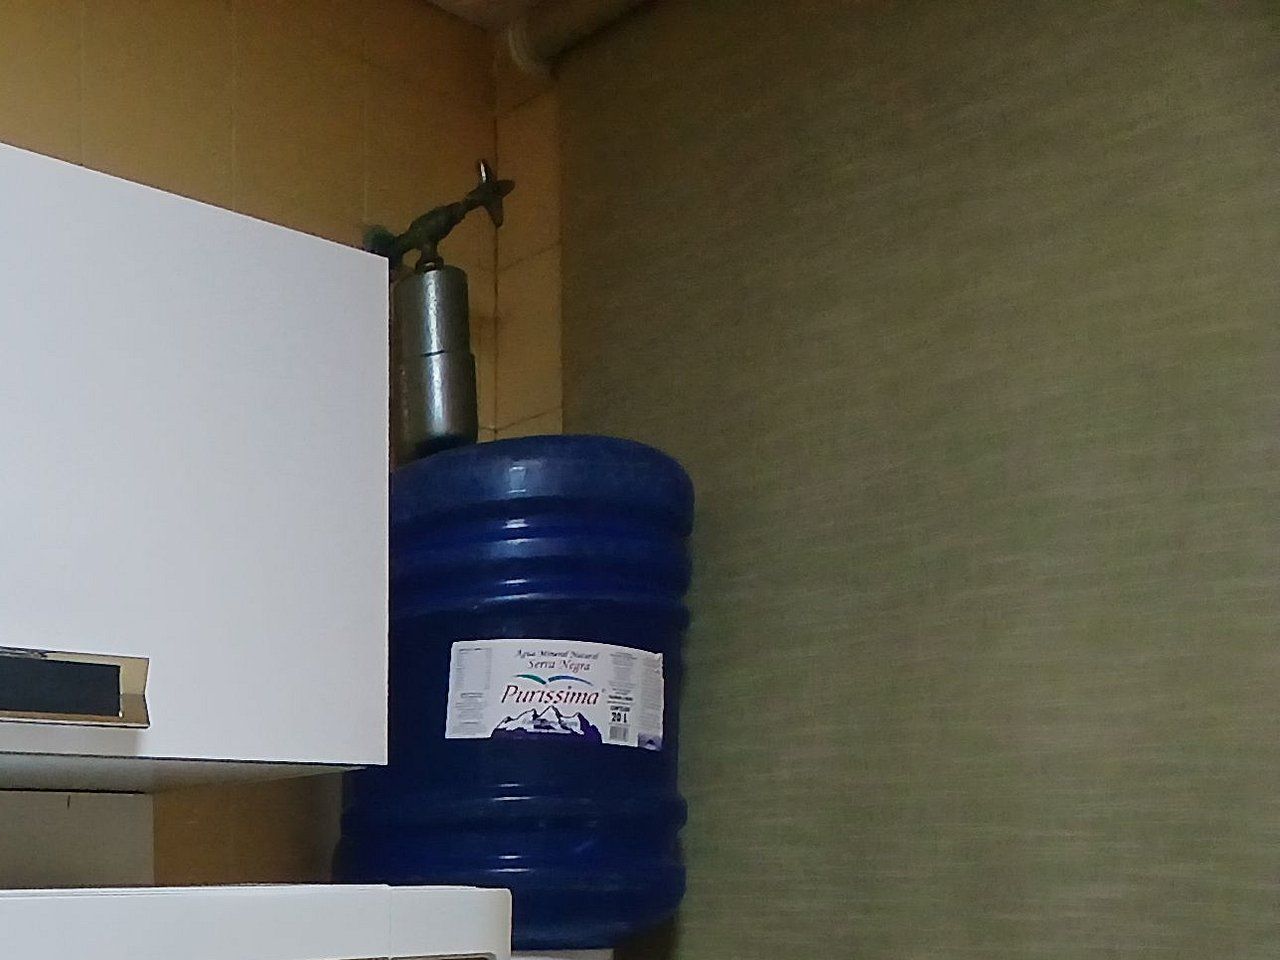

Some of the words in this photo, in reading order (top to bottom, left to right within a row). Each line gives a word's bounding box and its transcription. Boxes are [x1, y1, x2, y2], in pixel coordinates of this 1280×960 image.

[527, 660, 555, 669] Serra
[562, 659, 590, 673] Negra
[501, 684, 599, 704] Purissima
[611, 711, 622, 722] 20
